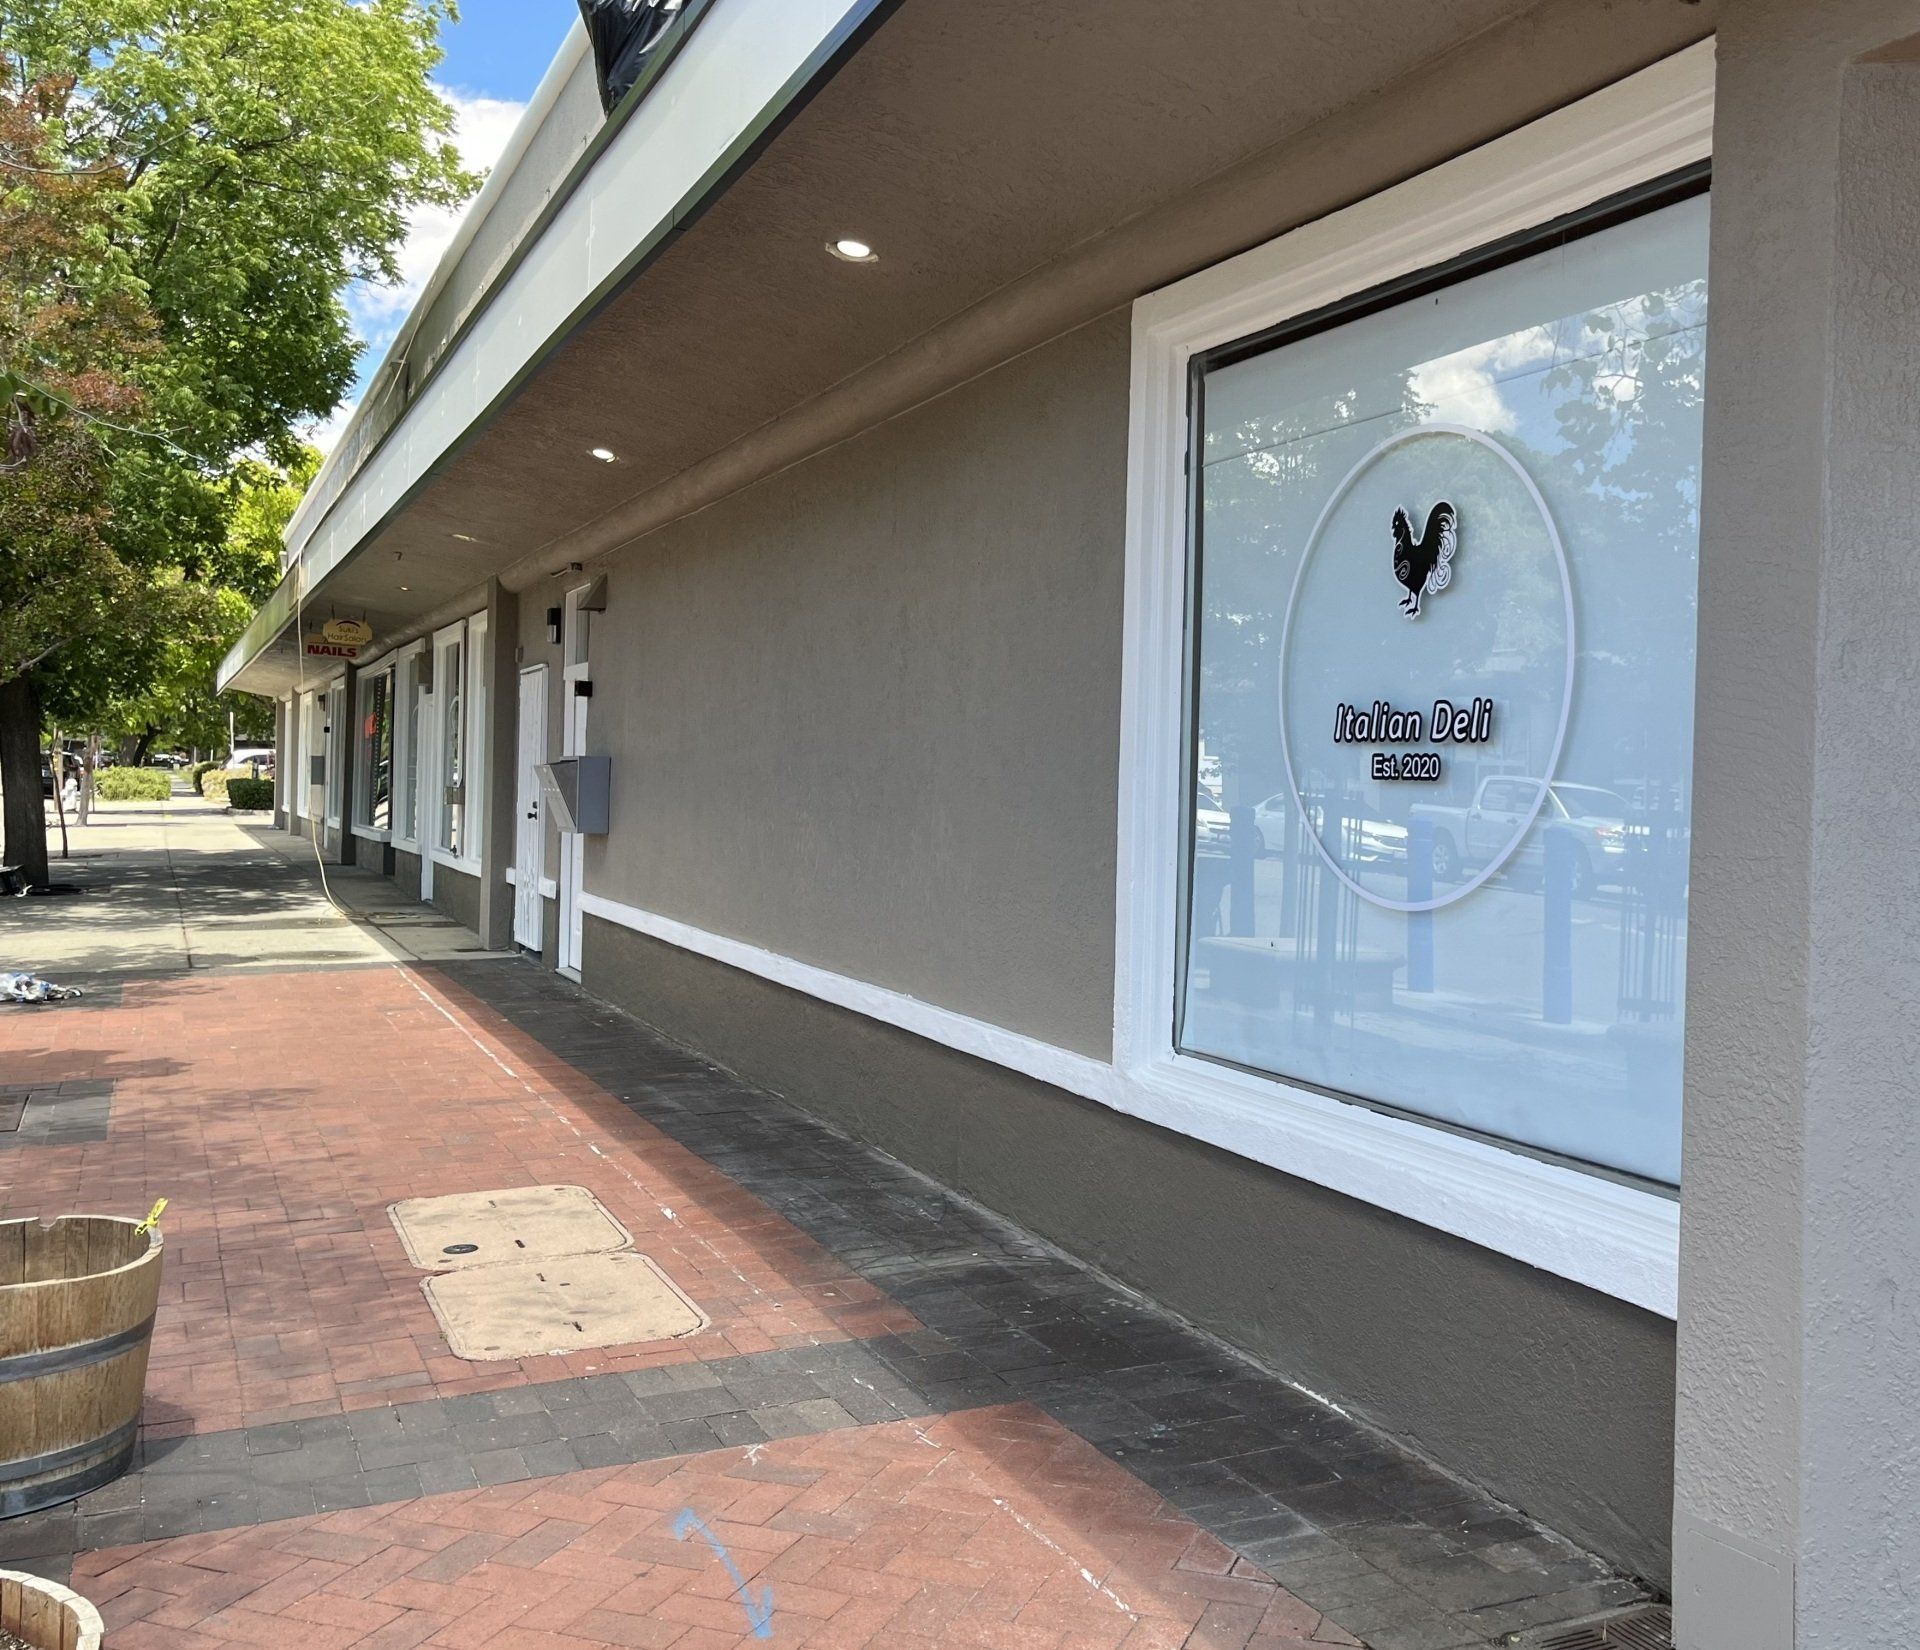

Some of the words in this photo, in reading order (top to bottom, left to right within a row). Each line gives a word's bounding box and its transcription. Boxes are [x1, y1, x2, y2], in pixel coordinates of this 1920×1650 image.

[307, 645, 357, 657] NAILS
[1334, 701, 1422, 743] Italian
[1430, 697, 1493, 743] Deli
[1372, 753, 1400, 780] Est.
[1401, 753, 1441, 780] 2020
